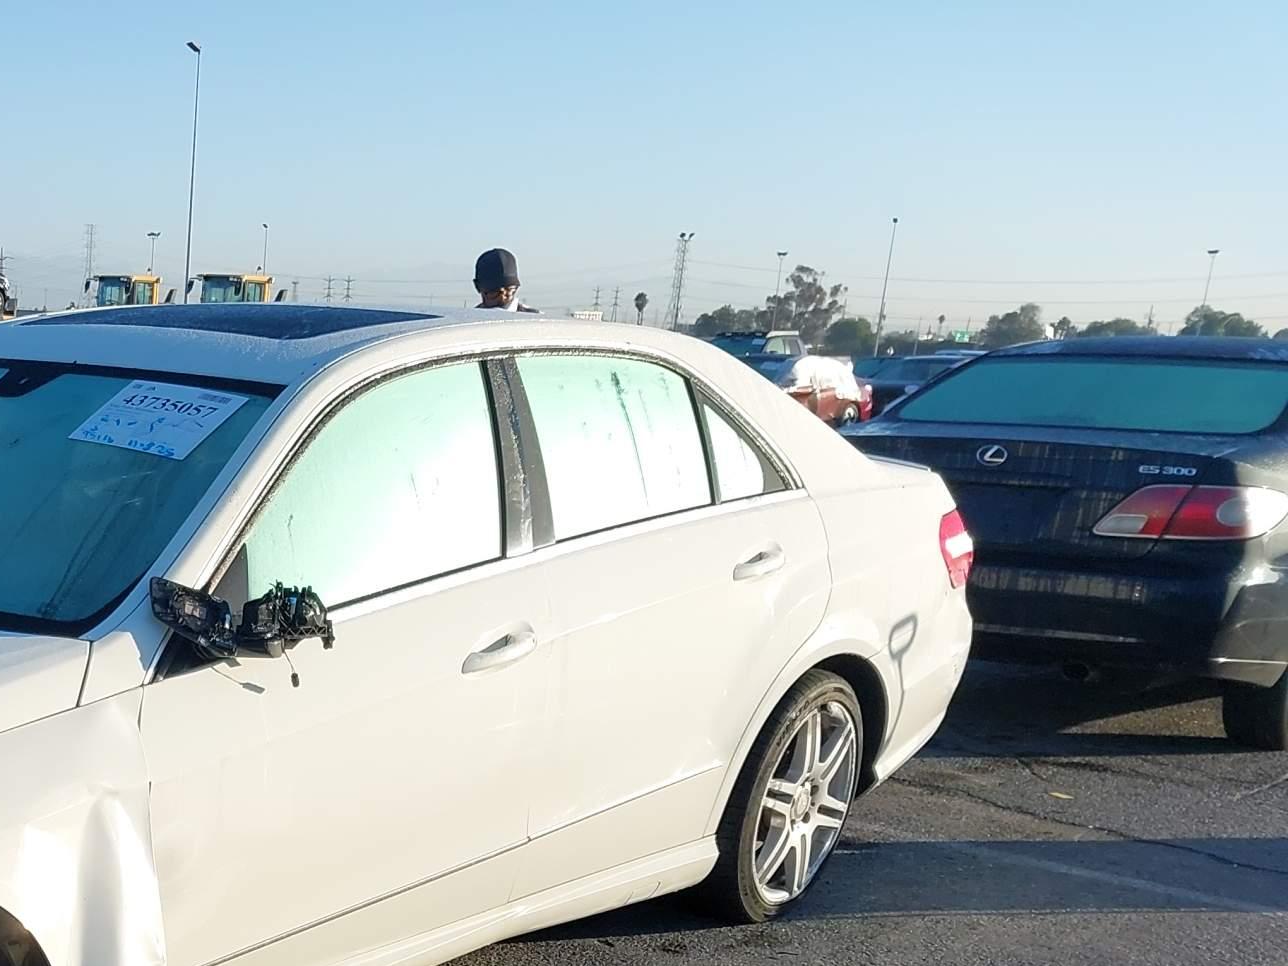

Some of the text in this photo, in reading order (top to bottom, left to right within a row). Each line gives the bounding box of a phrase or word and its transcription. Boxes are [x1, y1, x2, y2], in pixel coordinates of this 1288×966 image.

[122, 393, 219, 419] 43735057
[1138, 464, 1198, 477] ES 300
